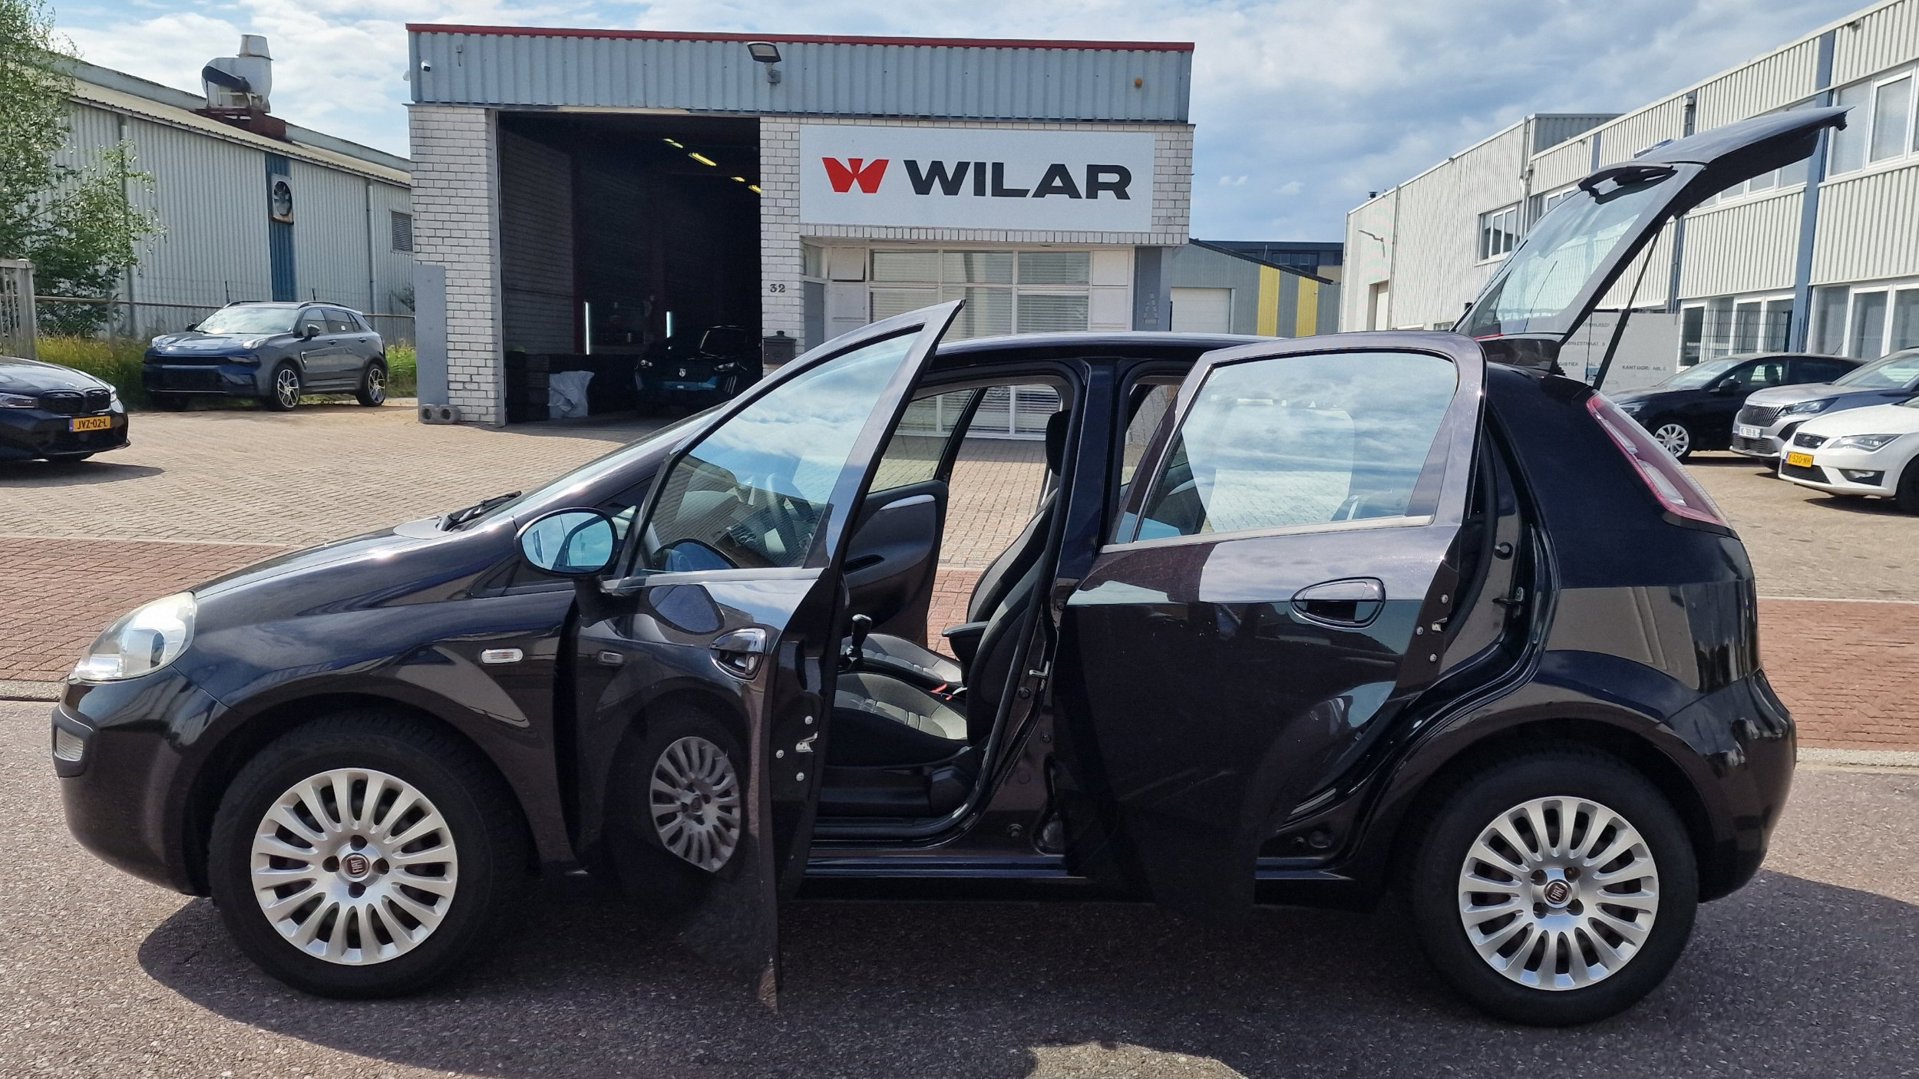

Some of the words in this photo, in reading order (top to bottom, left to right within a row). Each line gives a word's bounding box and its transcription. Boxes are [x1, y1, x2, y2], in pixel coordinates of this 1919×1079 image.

[903, 159, 1133, 200] WILAR
[769, 283, 786, 293] 32
[77, 418, 107, 430] JVZ-02-L
